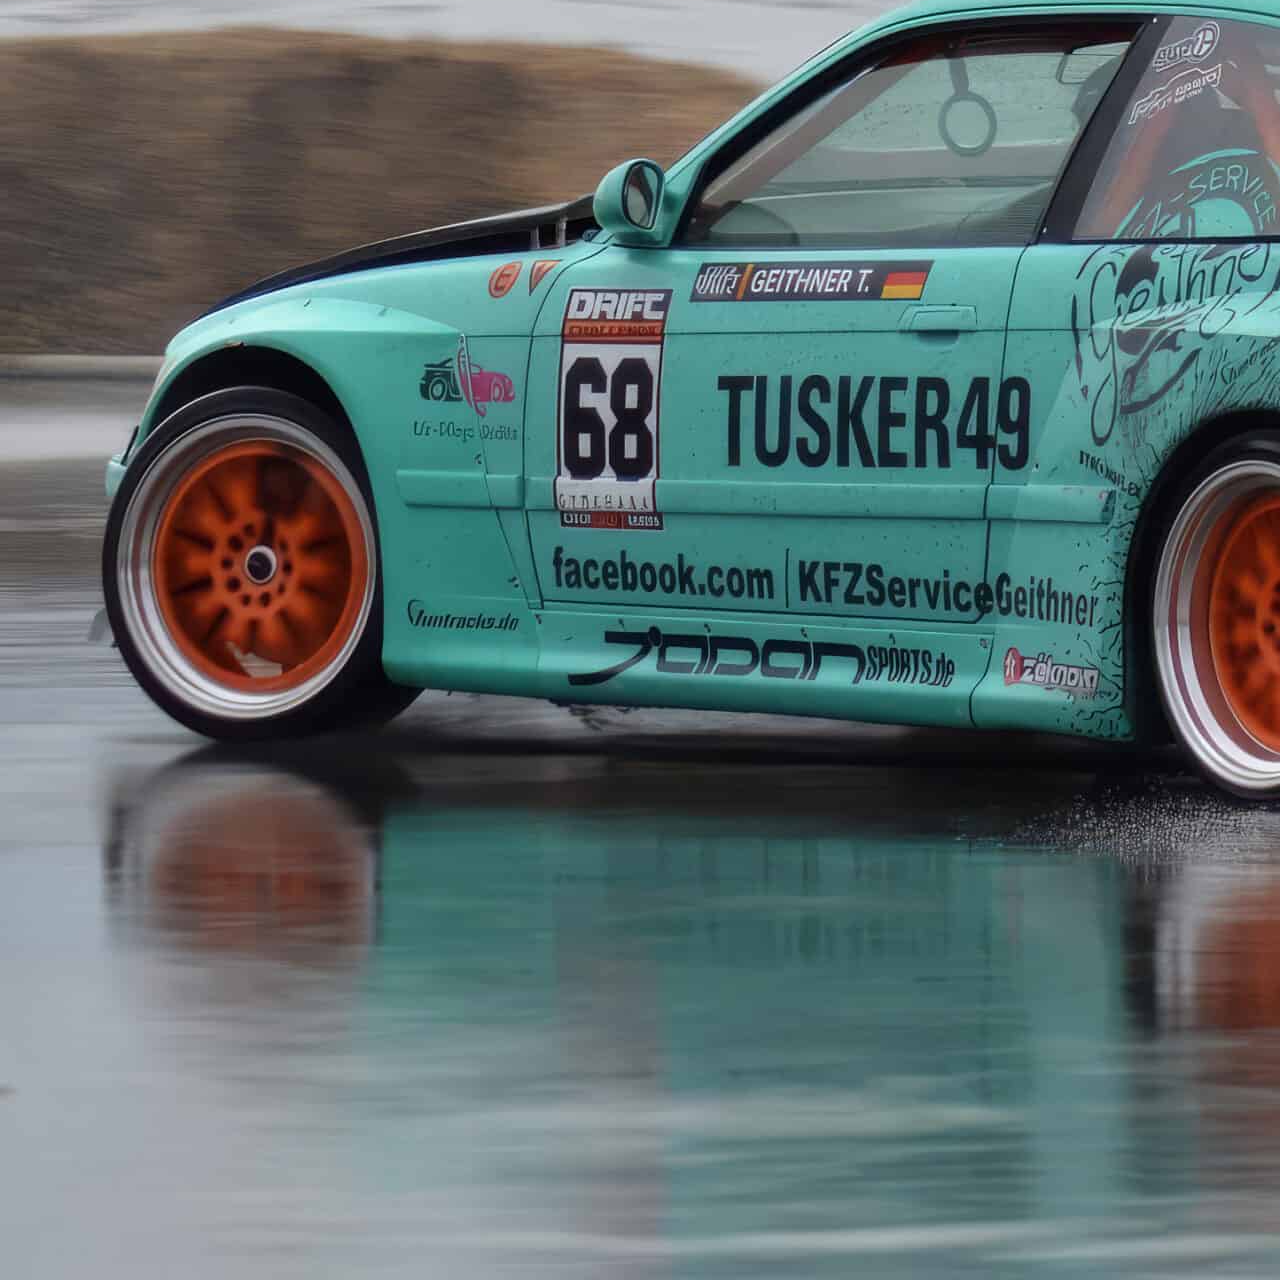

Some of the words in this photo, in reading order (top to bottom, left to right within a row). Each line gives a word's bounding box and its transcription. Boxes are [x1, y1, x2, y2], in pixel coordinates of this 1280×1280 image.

[751, 269, 851, 293] GEITHNER
[856, 269, 873, 292] T.
[563, 357, 654, 482] 68
[717, 374, 1031, 471] TUSKER49
[553, 546, 774, 600] facebook.com
